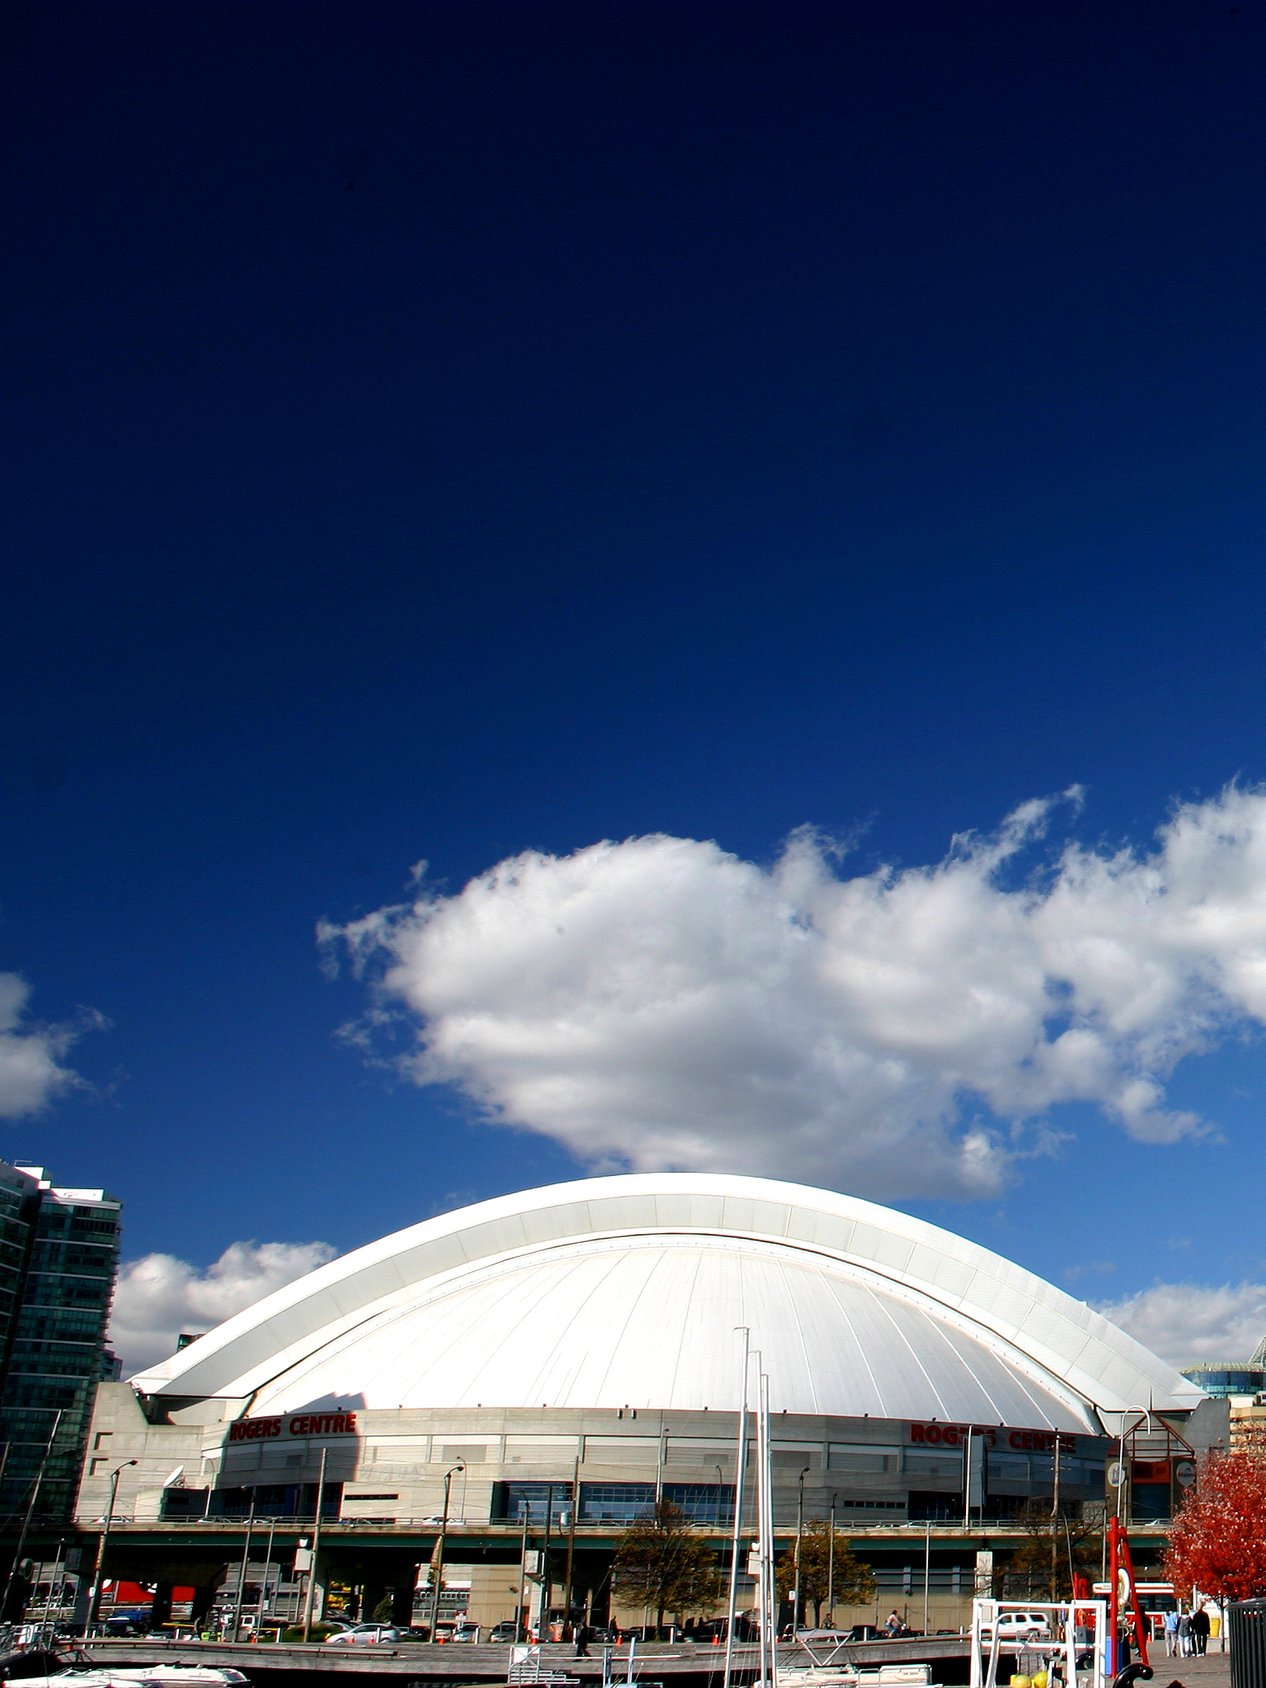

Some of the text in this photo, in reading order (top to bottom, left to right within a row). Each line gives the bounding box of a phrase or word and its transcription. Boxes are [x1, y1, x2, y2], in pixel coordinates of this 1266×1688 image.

[229, 1414, 357, 1441] ROGERS CENTRE
[911, 1423, 996, 1448] ROGS
